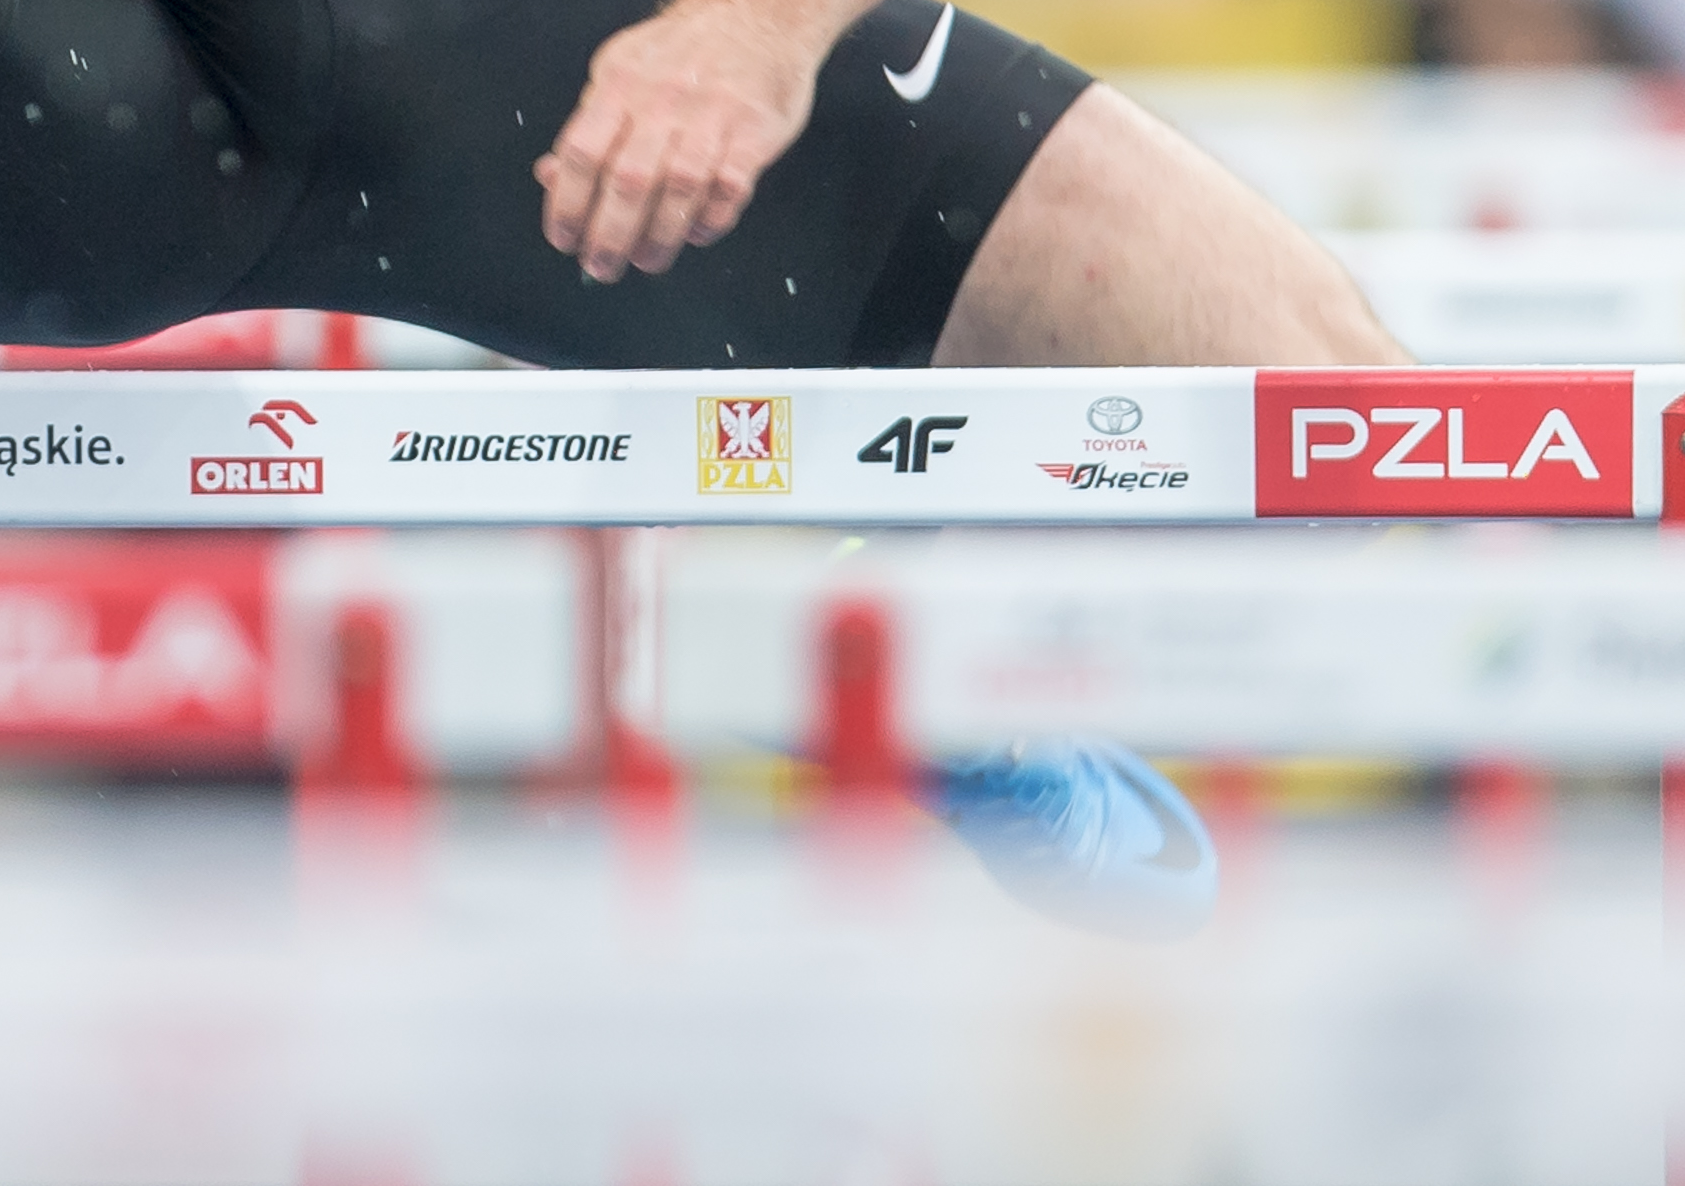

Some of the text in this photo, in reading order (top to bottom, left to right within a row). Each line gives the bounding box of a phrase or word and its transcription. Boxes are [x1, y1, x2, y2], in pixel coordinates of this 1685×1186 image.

[388, 431, 632, 462] BRIDGESTONE
[856, 415, 969, 474] 4F
[1082, 438, 1148, 452] TOYOTA
[1291, 407, 1601, 480] PZLA
[196, 461, 316, 491] ORLEN
[702, 463, 785, 489] PZLA
